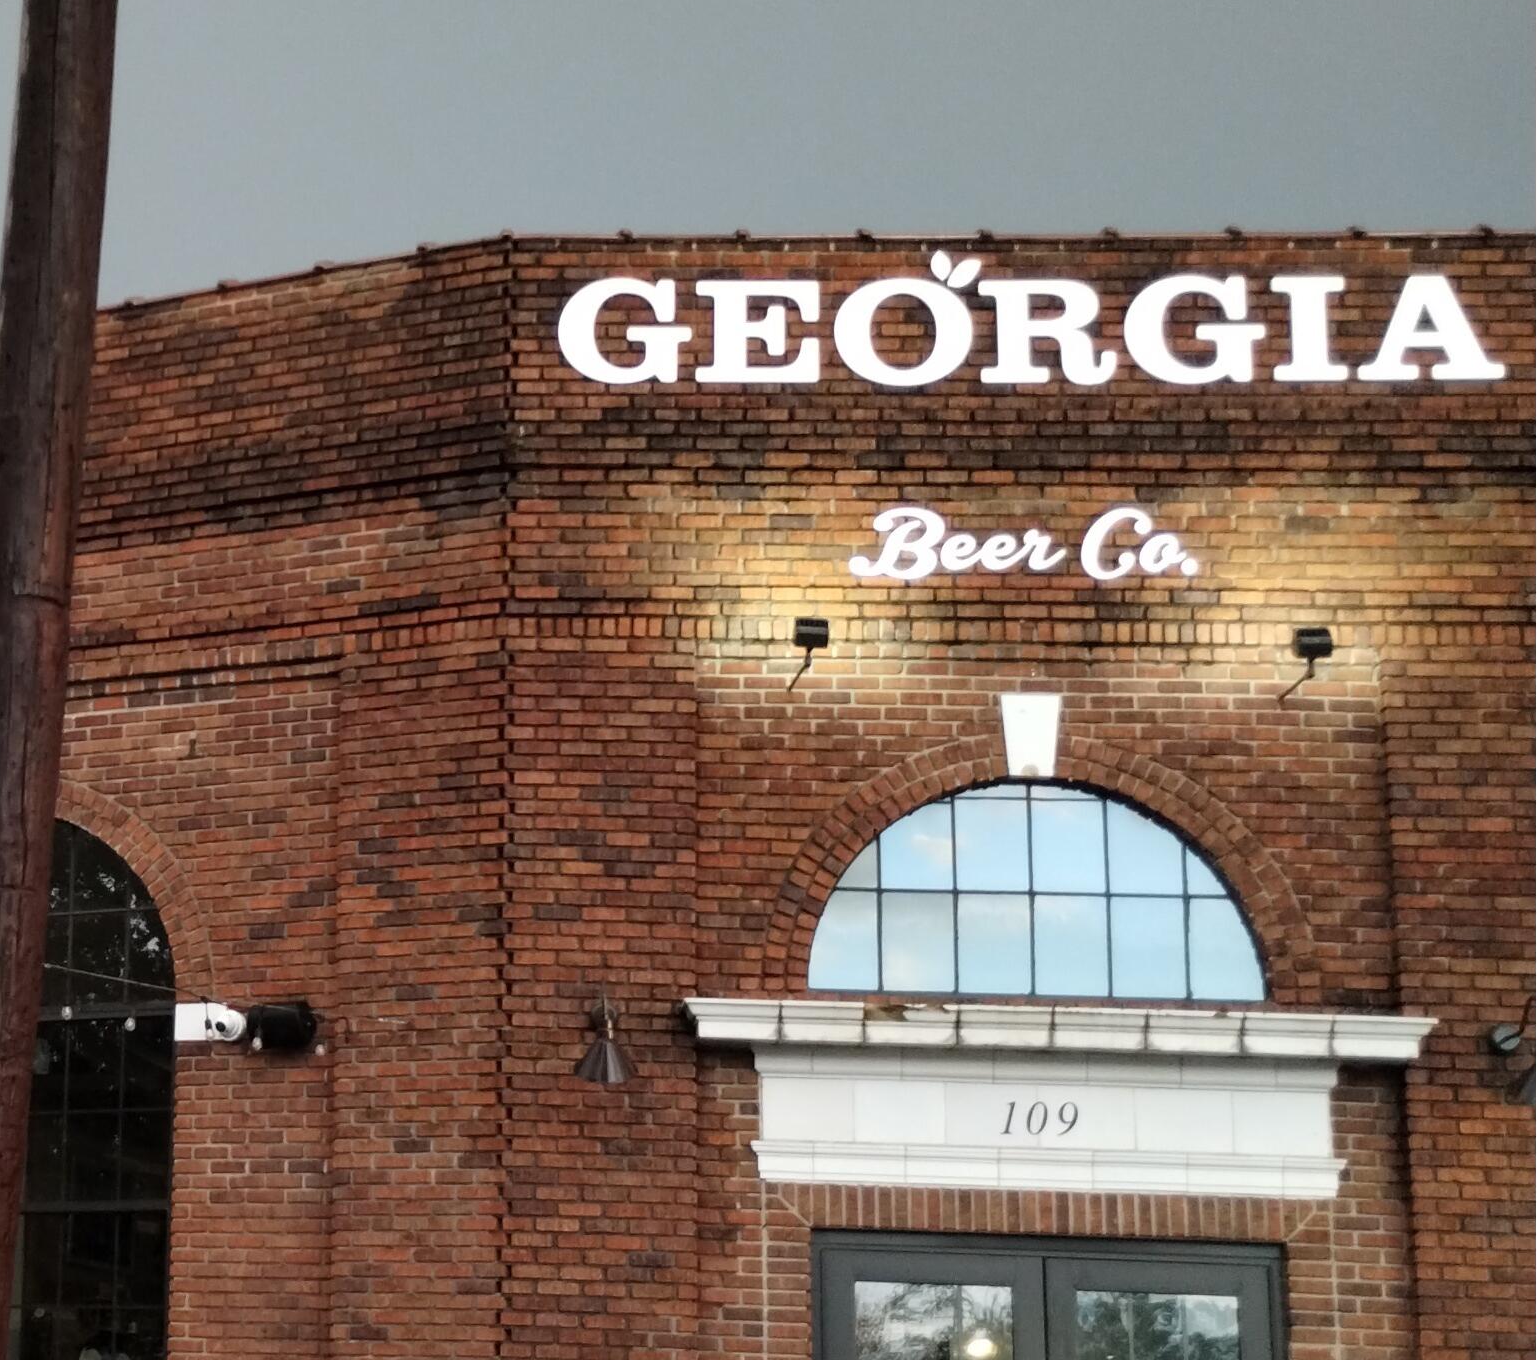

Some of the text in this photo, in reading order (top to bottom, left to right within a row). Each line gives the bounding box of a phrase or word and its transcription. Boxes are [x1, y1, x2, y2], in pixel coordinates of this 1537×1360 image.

[557, 275, 1506, 387] GEORGIA
[848, 506, 1200, 581] Beer Co.
[1000, 1100, 1080, 1136] 109
